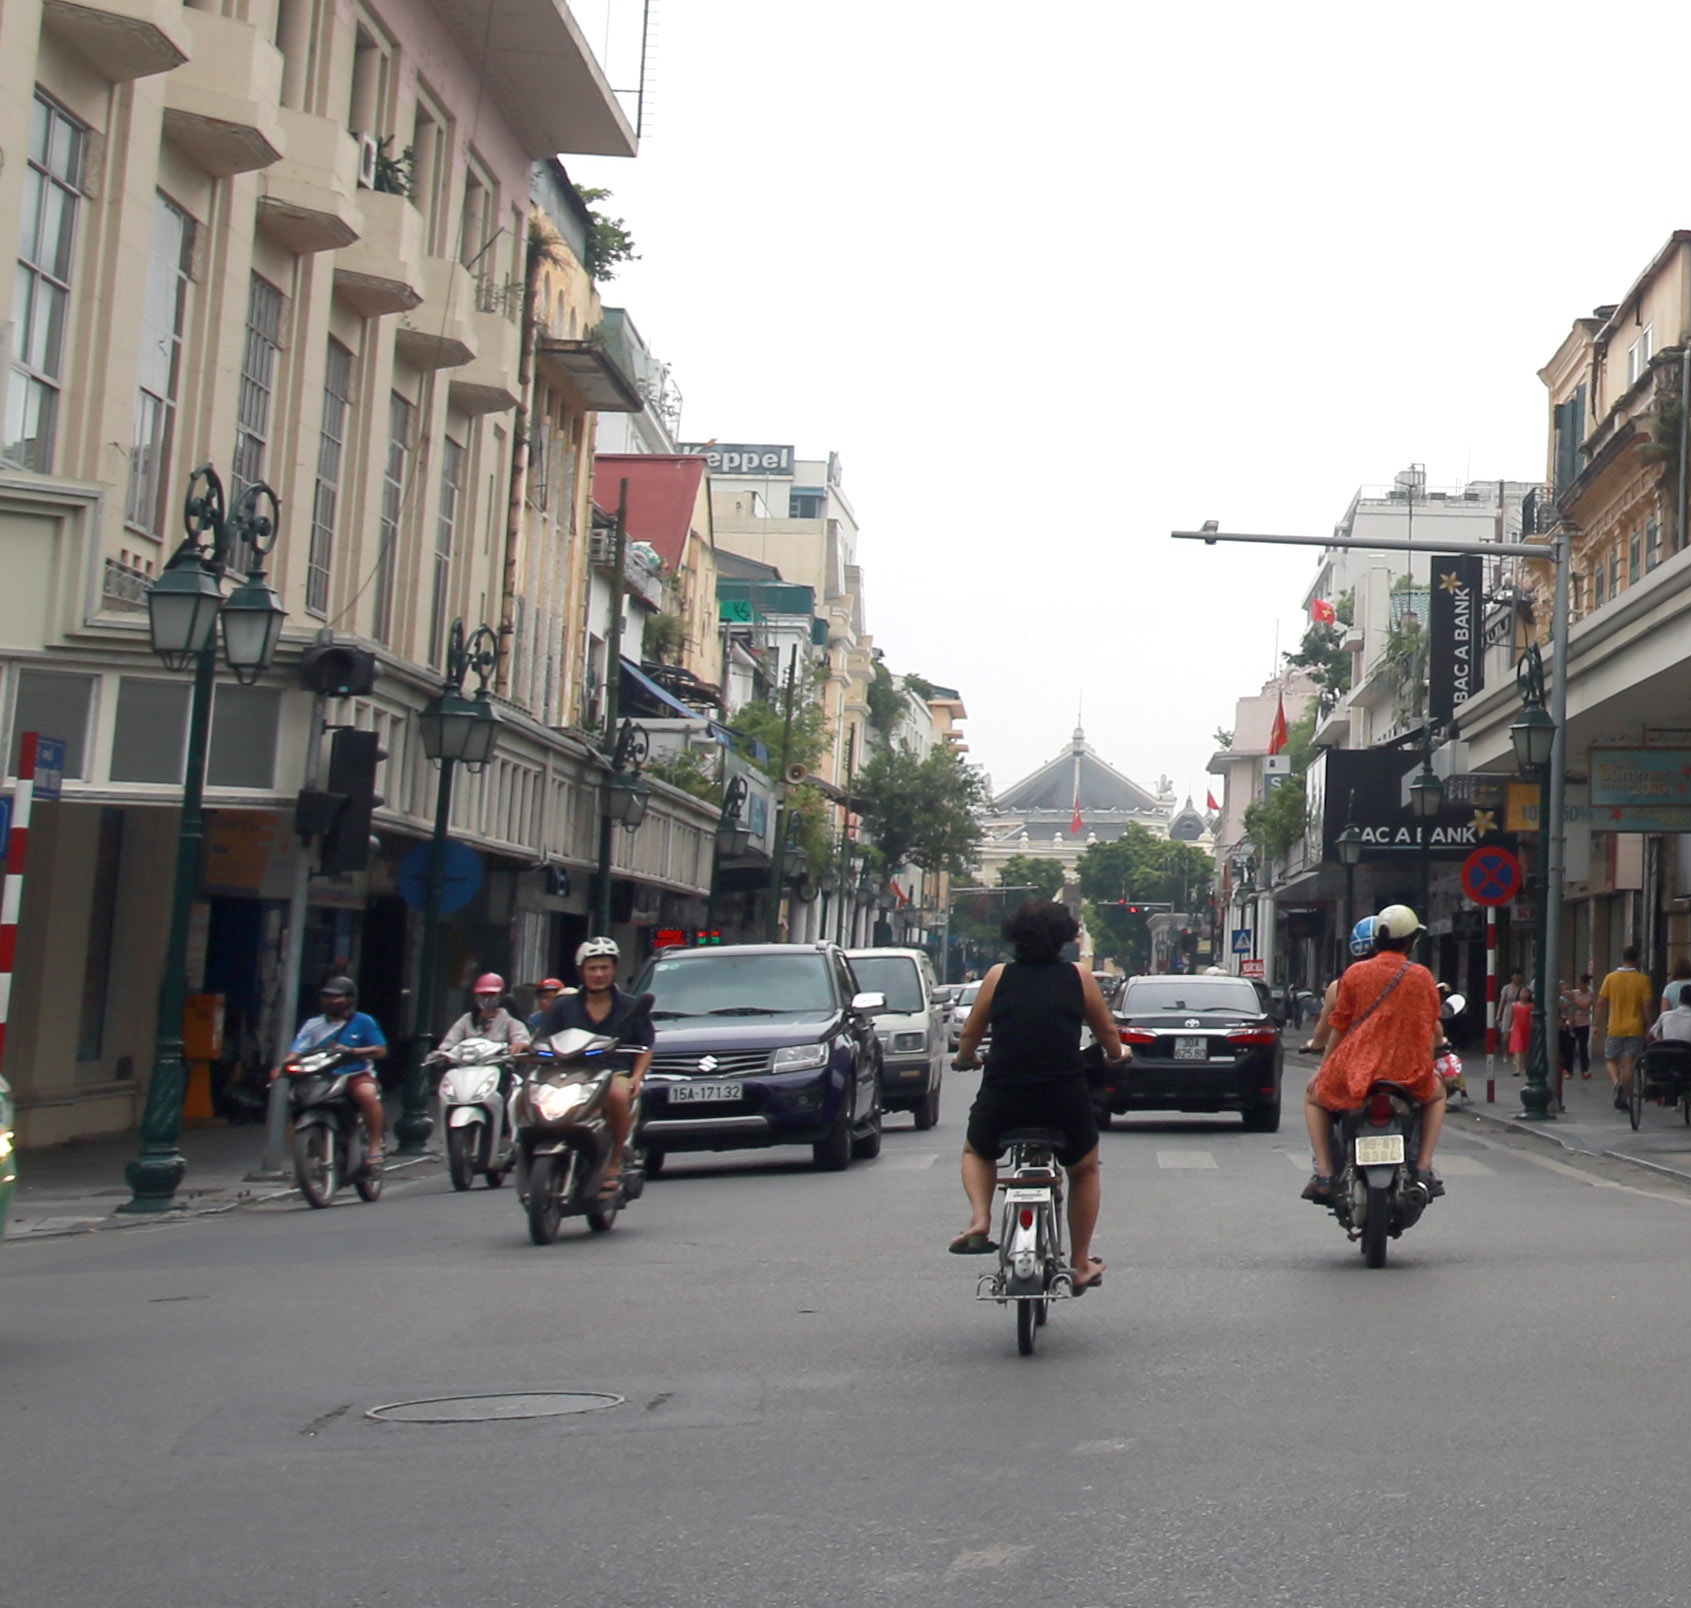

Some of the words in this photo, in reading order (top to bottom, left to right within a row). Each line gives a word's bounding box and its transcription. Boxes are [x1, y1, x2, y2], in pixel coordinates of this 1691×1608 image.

[1454, 587, 1470, 641] BANK
[1454, 645, 1469, 660] A
[1453, 663, 1469, 704] BAC
[1354, 826, 1390, 844] AC
[673, 1086, 741, 1101] 15A-171.32
